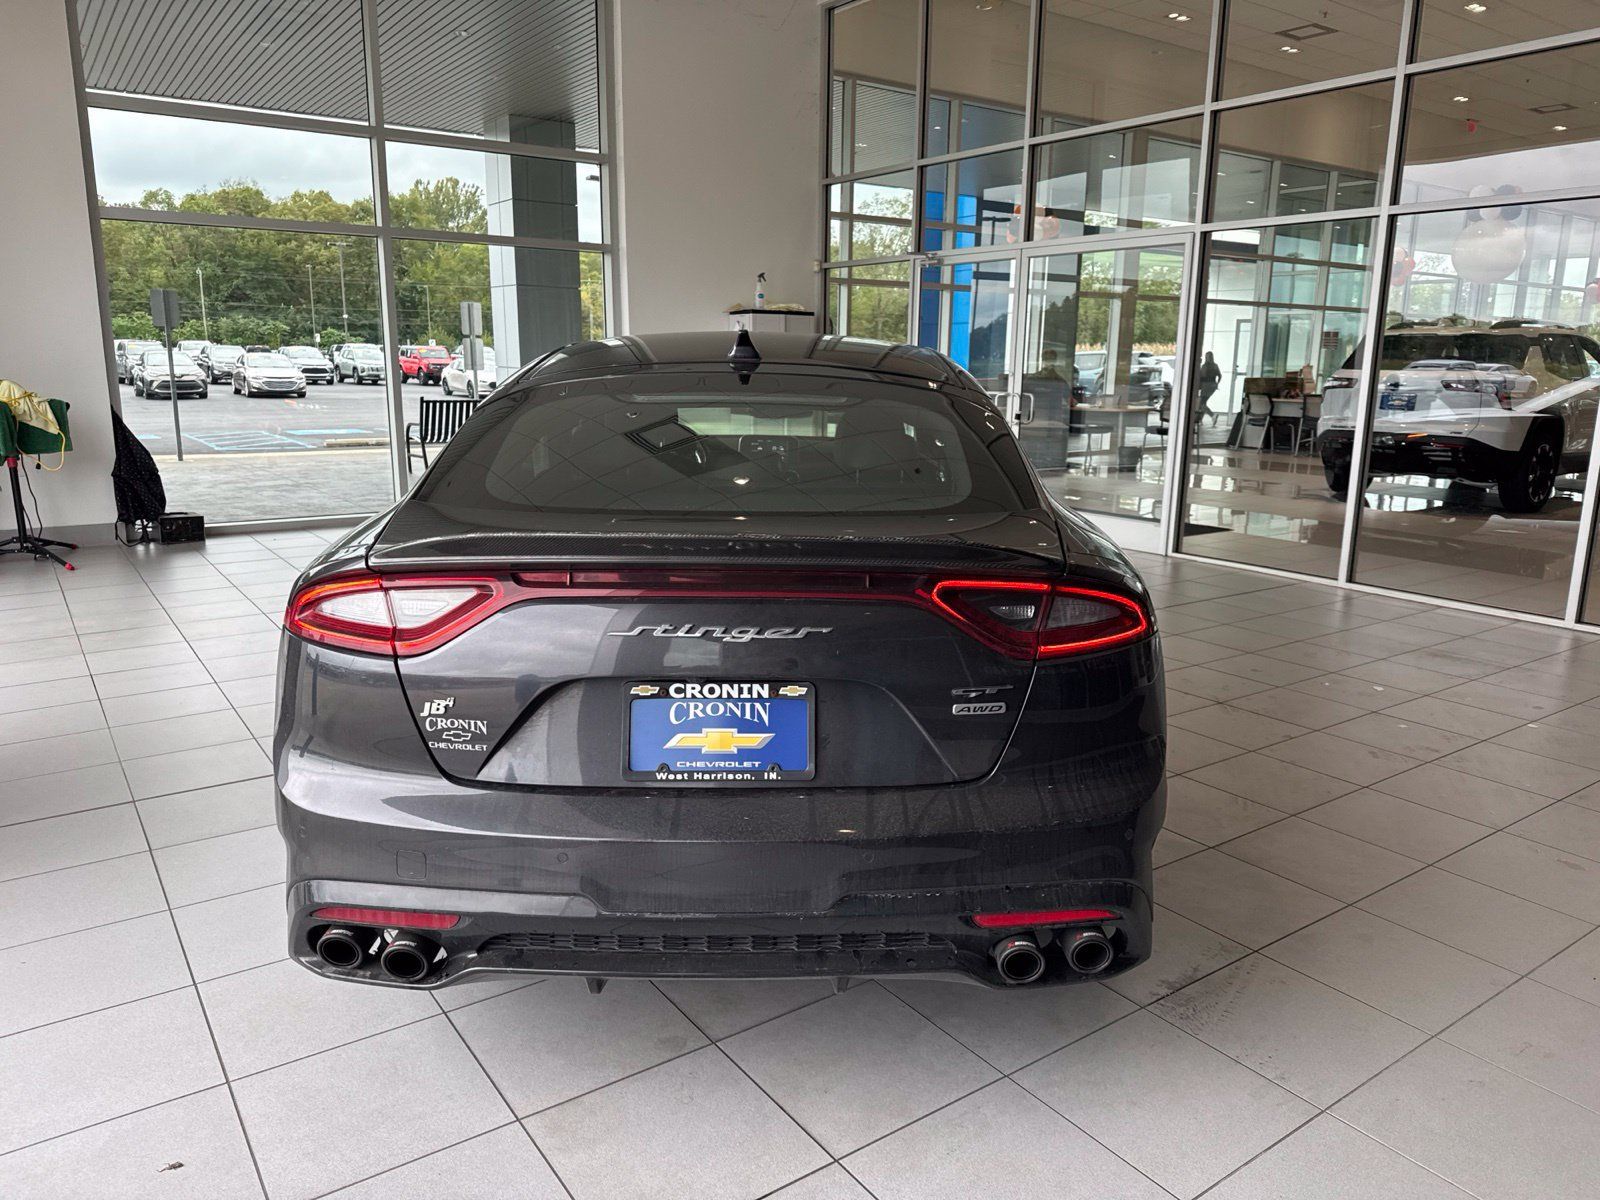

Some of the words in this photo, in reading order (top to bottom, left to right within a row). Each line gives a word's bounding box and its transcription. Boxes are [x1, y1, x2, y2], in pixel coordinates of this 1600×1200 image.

[607, 623, 833, 643] stinger
[669, 683, 769, 699] CRONIN
[669, 701, 770, 727] CRONIN
[957, 705, 1003, 713] AWD
[425, 717, 487, 735] CRONIN
[429, 741, 488, 751] CHEVROLET
[656, 772, 688, 780] West
[693, 772, 755, 781] Harrison,
[764, 772, 781, 780] IN.
